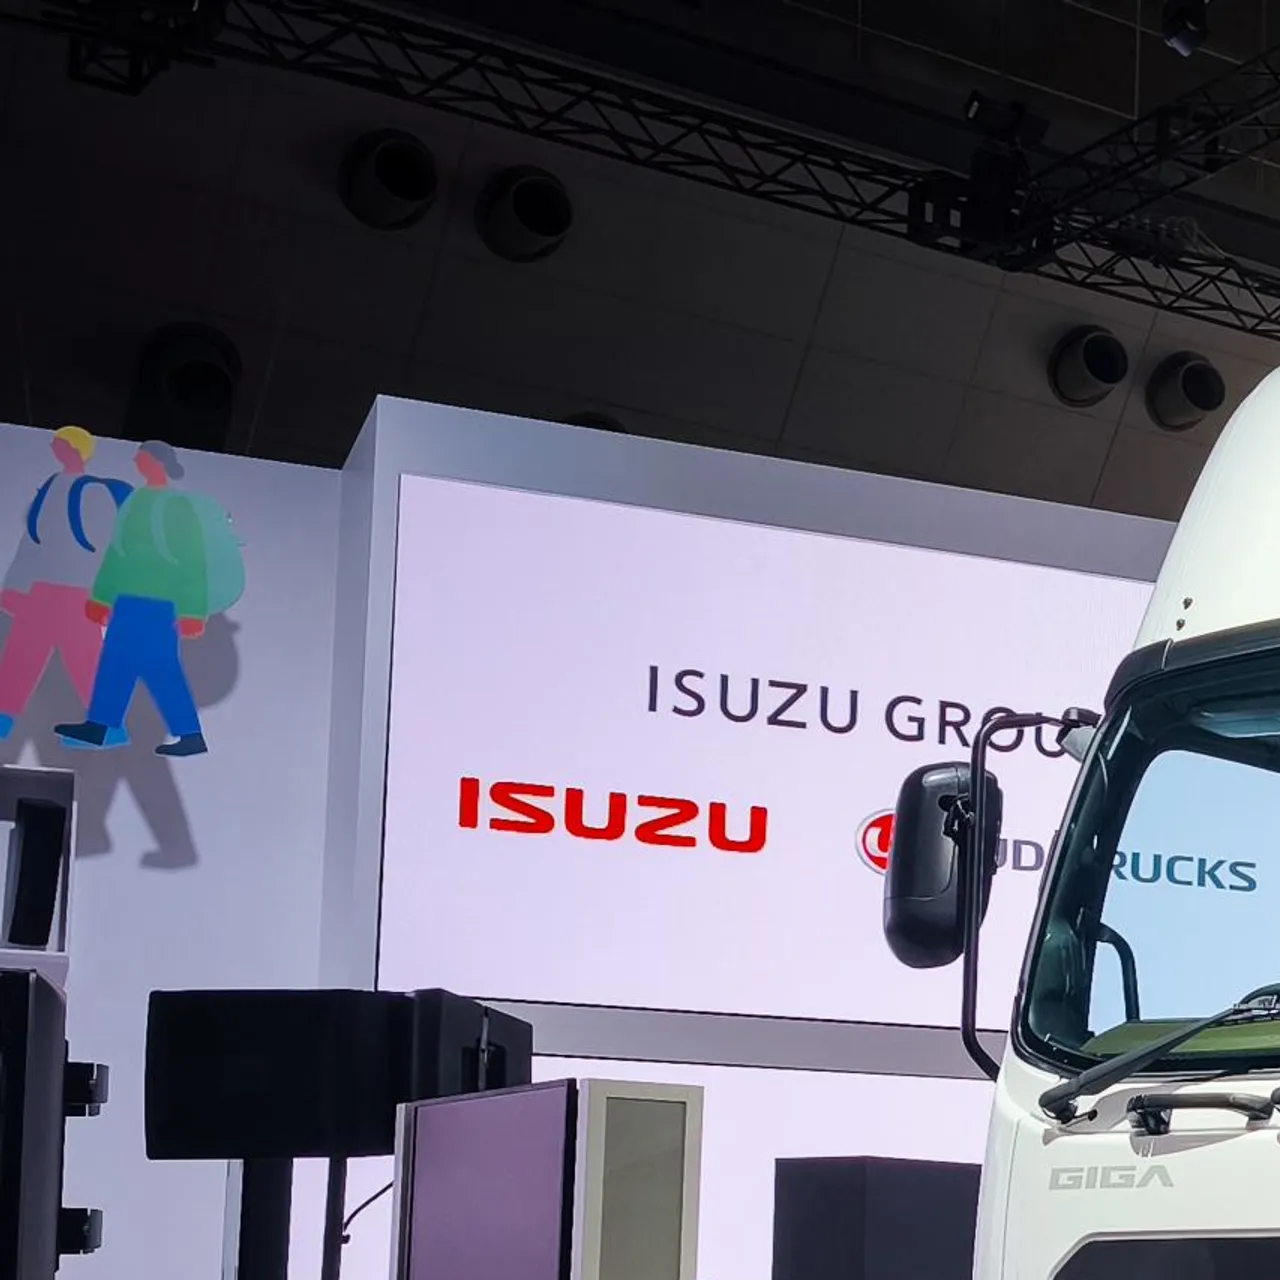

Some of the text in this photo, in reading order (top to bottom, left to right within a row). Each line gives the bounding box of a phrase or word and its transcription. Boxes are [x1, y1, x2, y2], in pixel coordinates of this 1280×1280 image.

[648, 665, 1066, 758] ISUZU GROU
[458, 776, 768, 853] ISUZU
[1111, 850, 1258, 892] RUCKS
[1049, 1164, 1175, 1190] GIGA
